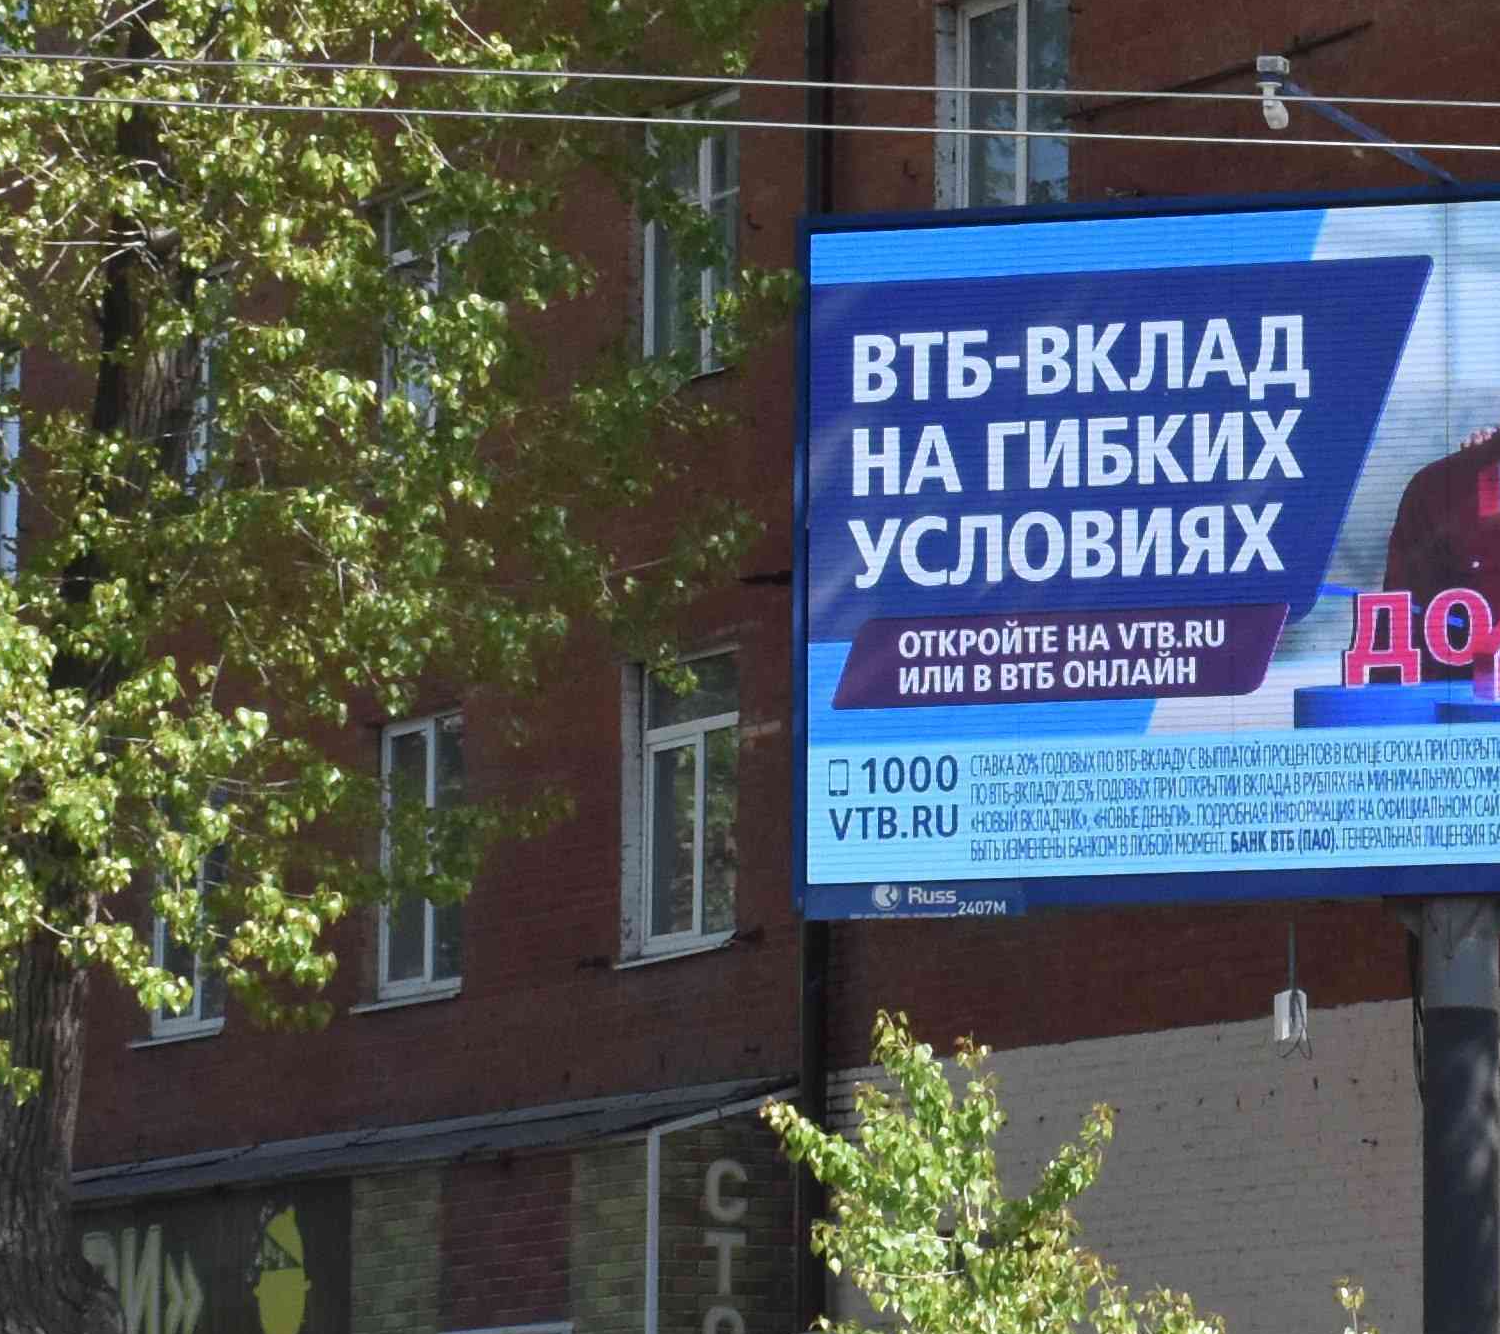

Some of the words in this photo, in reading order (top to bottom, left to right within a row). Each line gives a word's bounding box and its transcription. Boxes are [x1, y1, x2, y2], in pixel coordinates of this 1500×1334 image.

[853, 315, 1310, 403] ВТБ-ВКЛАД
[853, 425, 962, 496] НА
[987, 409, 1303, 491] ГИБКИХ
[848, 503, 1283, 589] УСЛОВИЯХ
[899, 621, 1058, 659] ОТКРОЙТЕ
[1068, 625, 1110, 652] НА
[1118, 619, 1225, 650] VTB.RU
[899, 665, 964, 694] ИЛИ
[974, 664, 991, 692] В
[1001, 662, 1055, 691] ВТБ
[1063, 651, 1195, 687] ОНЛАЙН
[860, 755, 959, 794] 1000
[829, 804, 959, 841] VTB.RU
[908, 886, 957, 904] Russ
